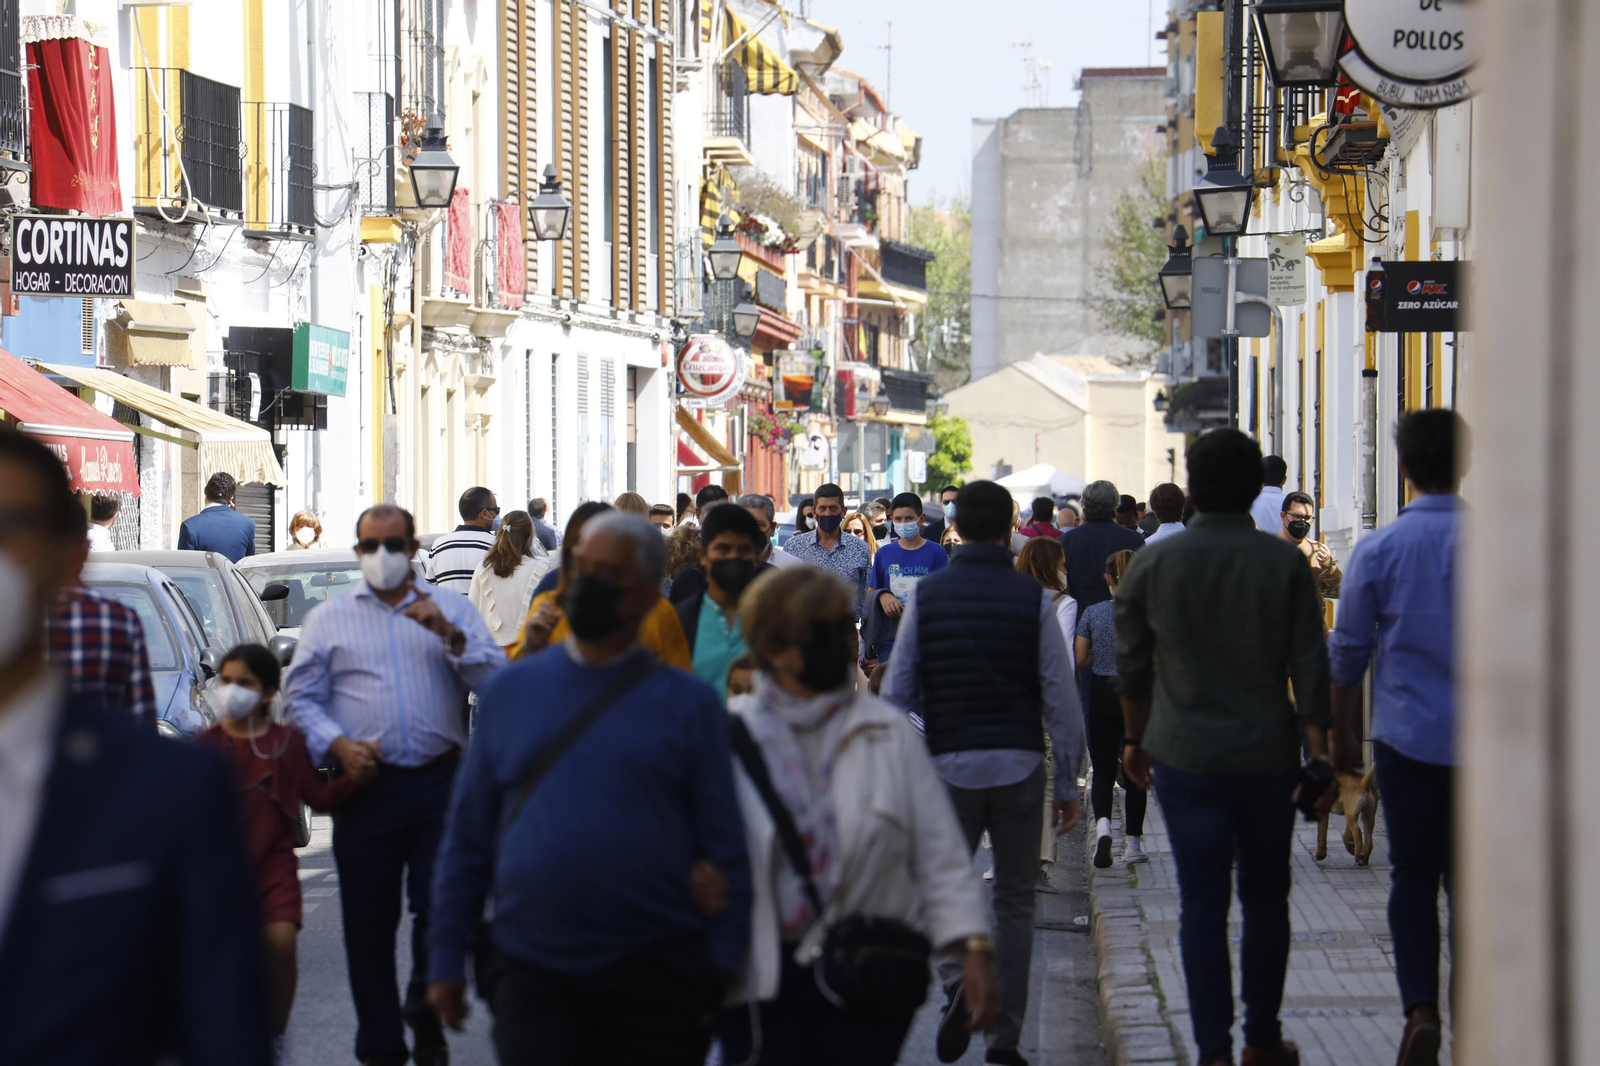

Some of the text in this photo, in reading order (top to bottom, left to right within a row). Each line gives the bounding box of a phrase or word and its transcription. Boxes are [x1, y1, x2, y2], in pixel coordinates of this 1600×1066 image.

[1393, 29, 1464, 50] POLLOS
[1375, 79, 1406, 100] BUBU
[16, 219, 128, 267] CORTINAS
[15, 271, 50, 291] HOGAR
[65, 273, 128, 294] DECORACION
[1421, 284, 1448, 294] MAX
[1397, 299, 1459, 309] ZERO AZÚCAR
[683, 362, 731, 374] Cruzcampo
[889, 565, 913, 577] BEACH
